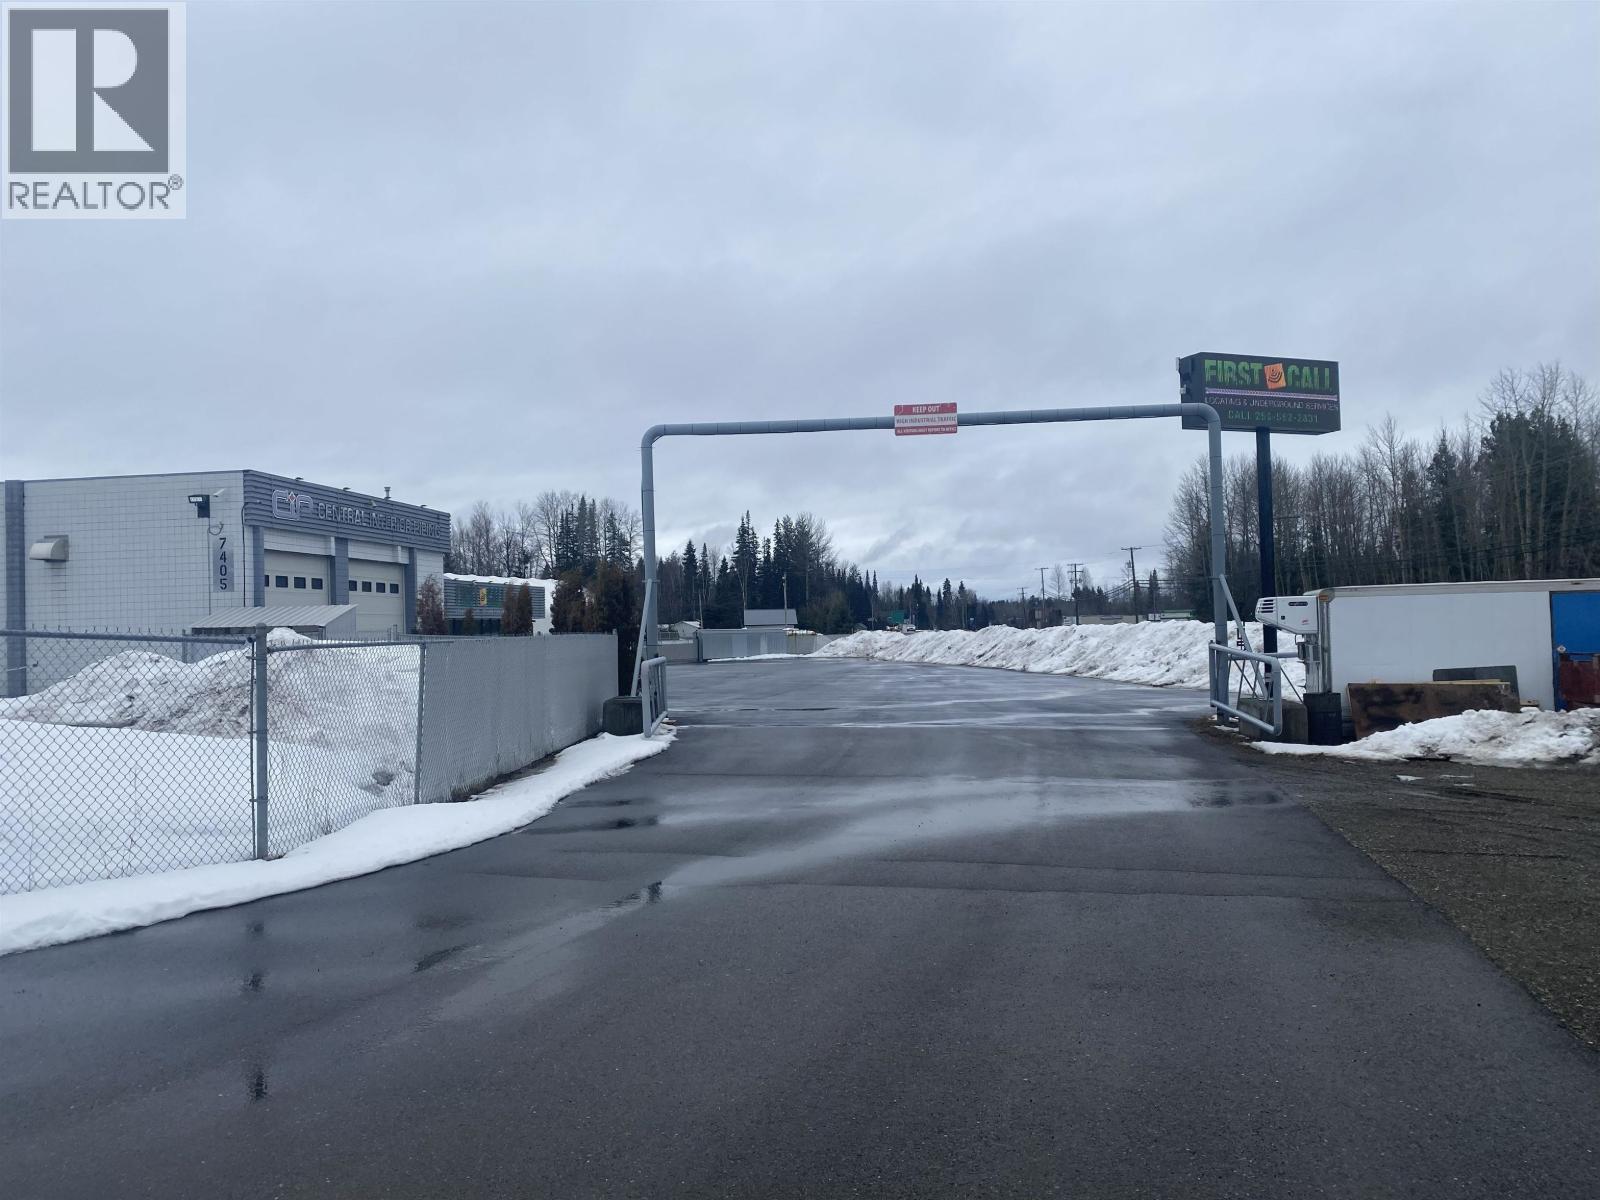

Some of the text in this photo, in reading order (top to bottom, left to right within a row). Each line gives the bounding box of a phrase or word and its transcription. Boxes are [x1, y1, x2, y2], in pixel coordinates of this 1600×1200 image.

[1204, 359, 1262, 385] FIRST
[912, 405, 940, 413] KEEP OUT
[1205, 397, 1241, 406] LOCATING
[1249, 399, 1303, 409] UNDERGROUND
[318, 502, 441, 538] CENTRAL INTERIOR PIPING
[219, 538, 228, 591] 7405
